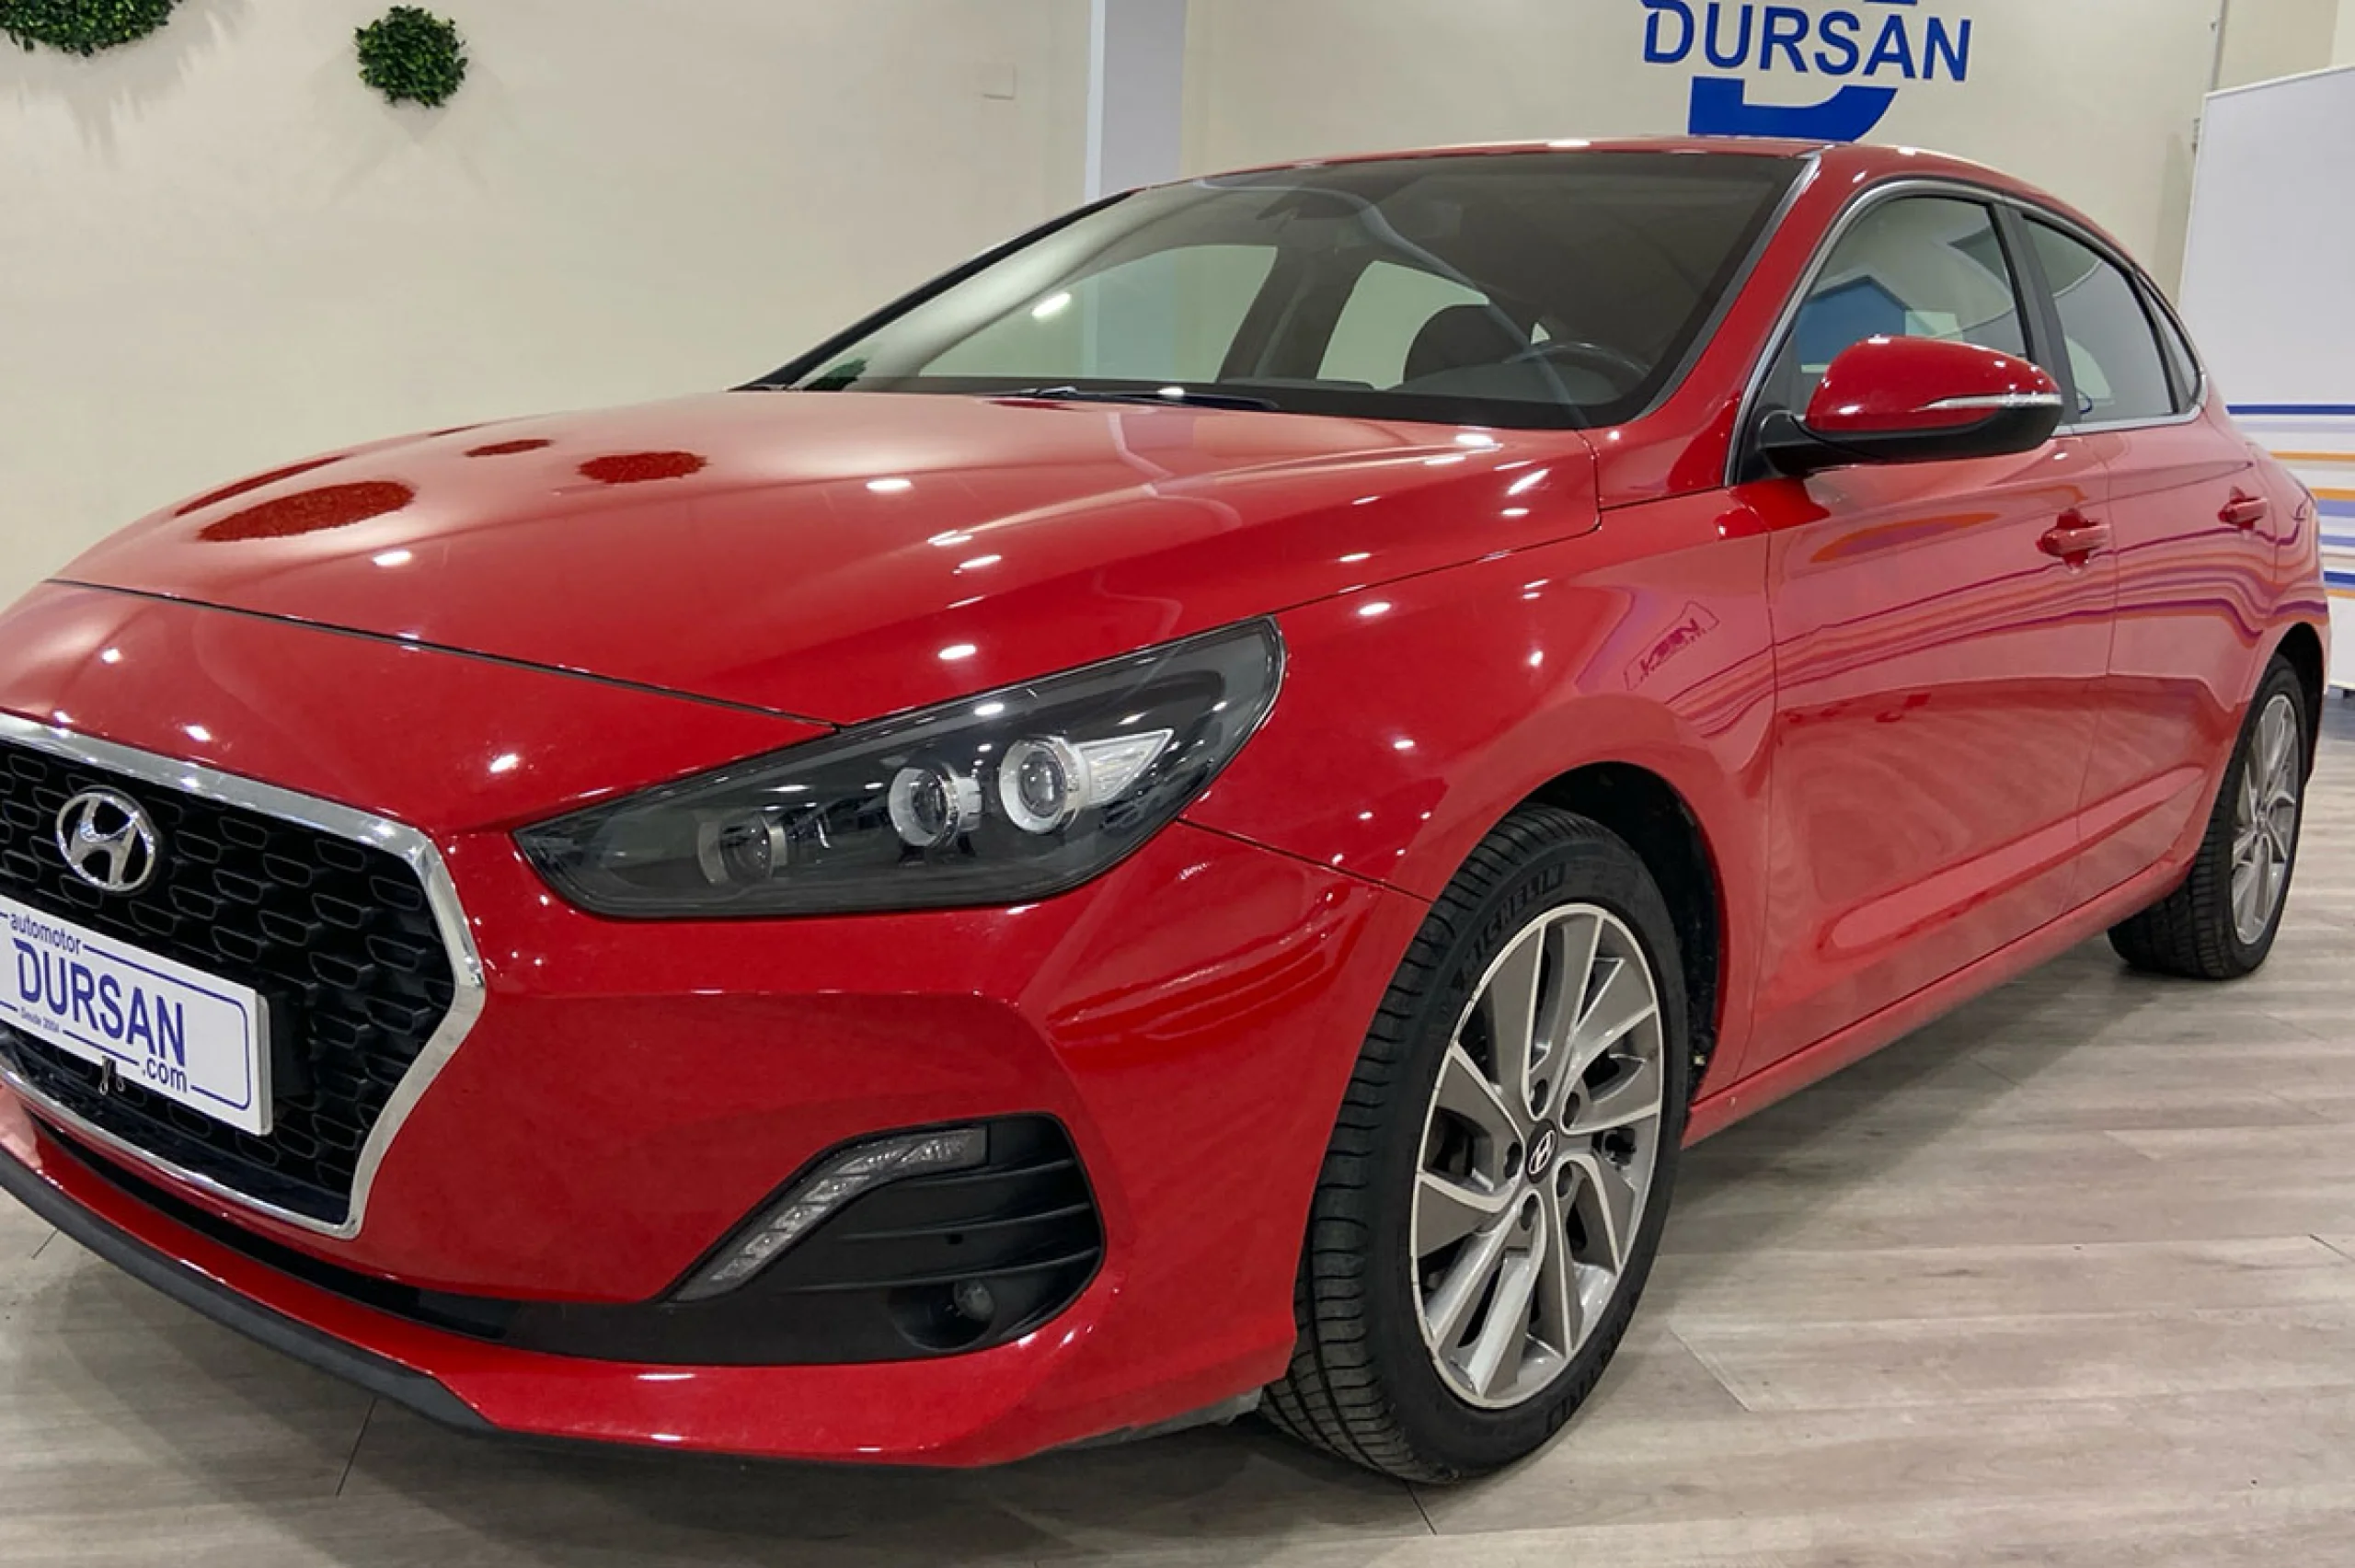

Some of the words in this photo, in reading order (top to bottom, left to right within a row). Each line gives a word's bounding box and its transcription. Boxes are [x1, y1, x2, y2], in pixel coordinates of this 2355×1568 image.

[1641, 0, 1972, 82] DURSAN
[10, 913, 82, 954] automotor
[13, 937, 185, 1067] DURSAN
[142, 1058, 188, 1093] .com
